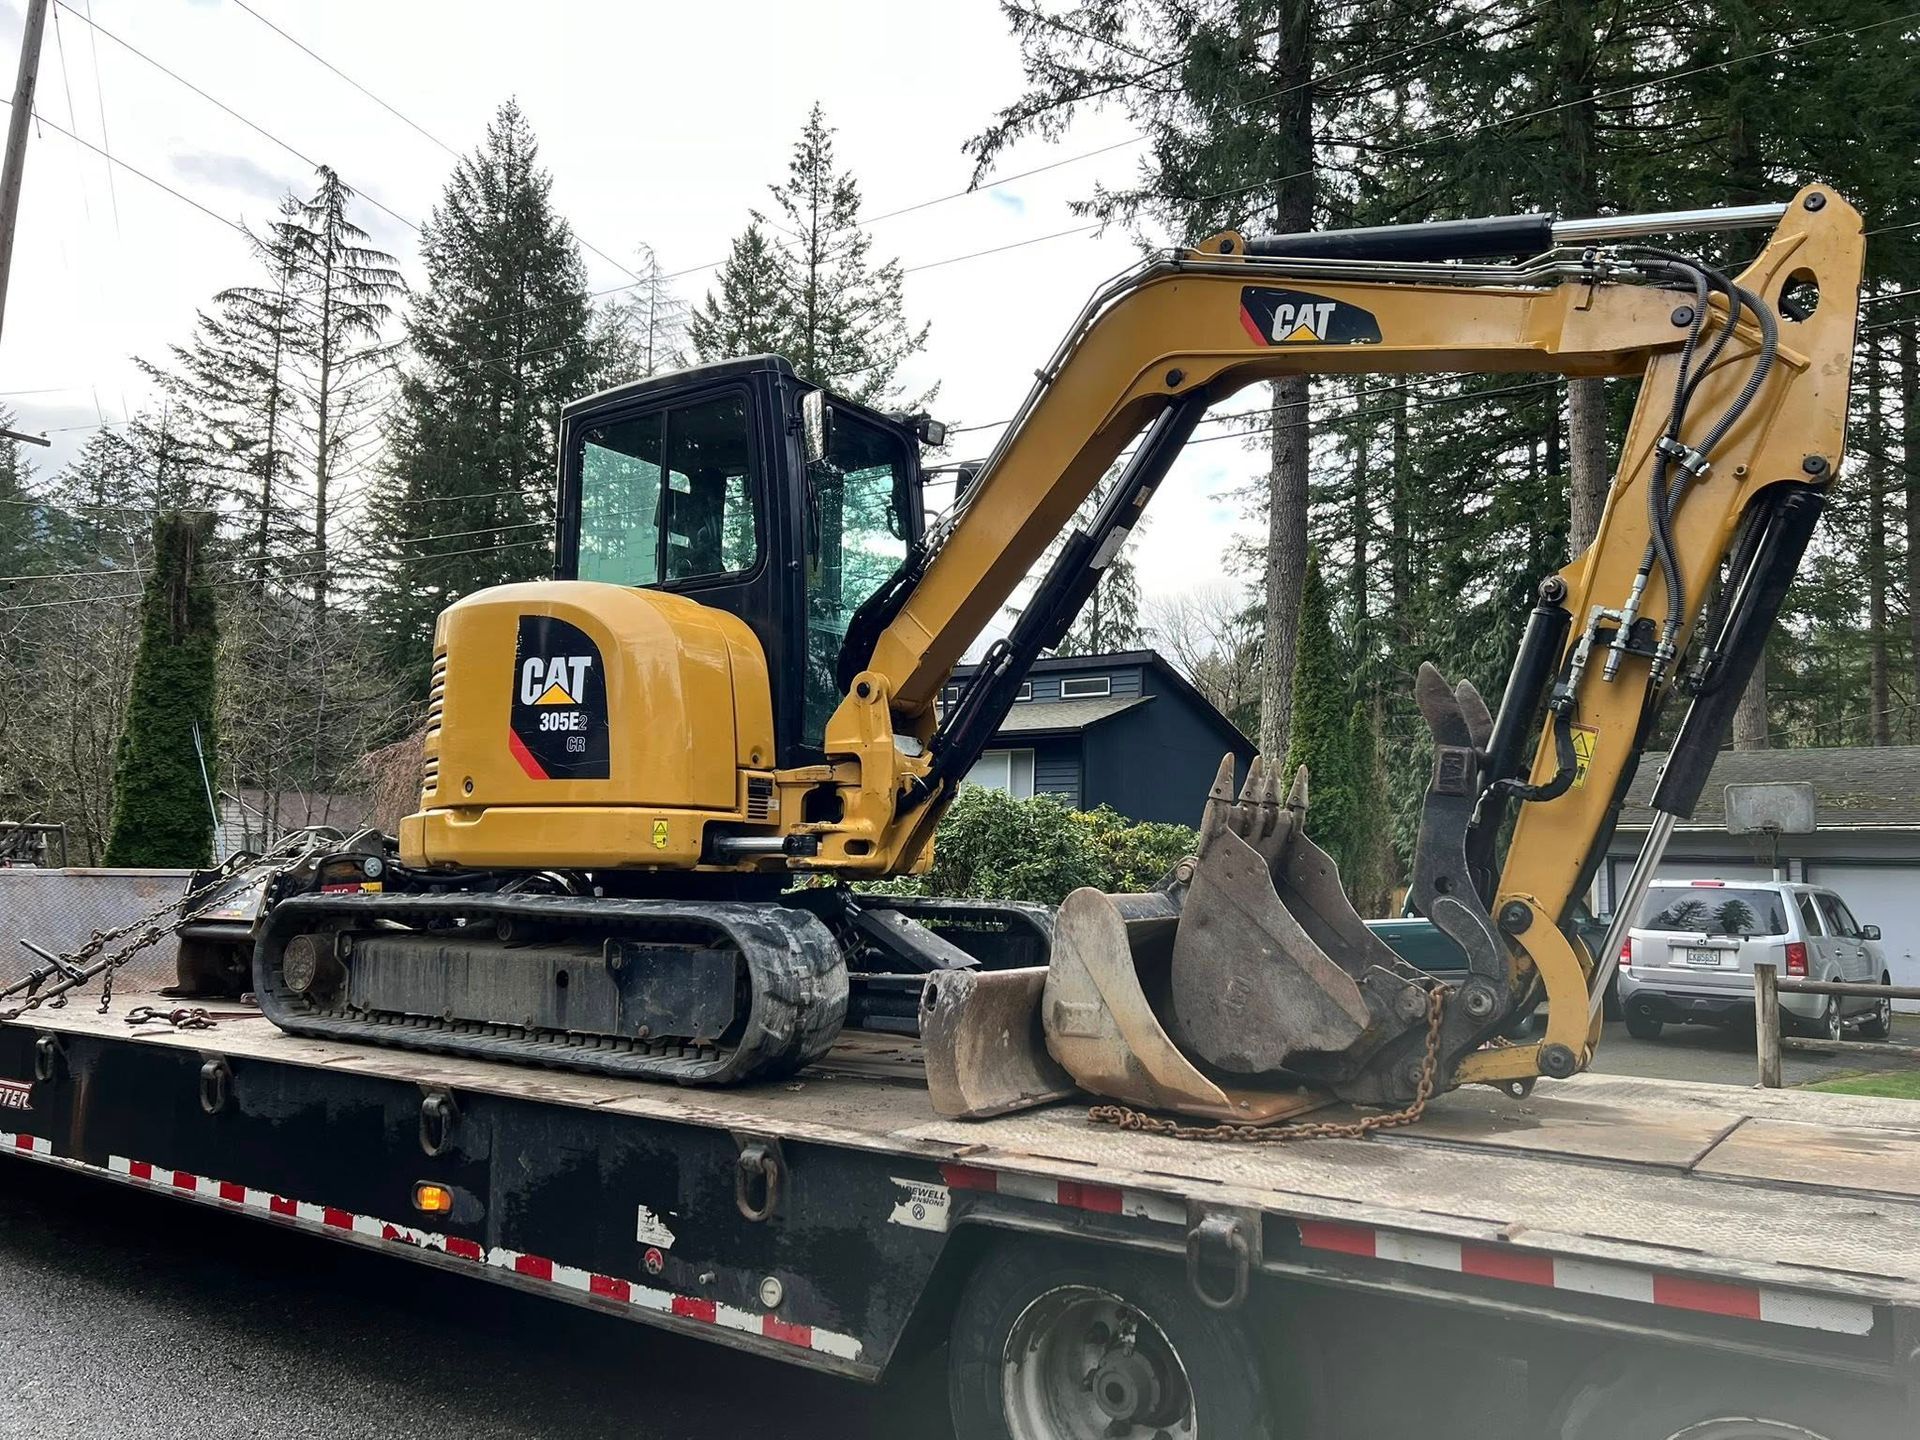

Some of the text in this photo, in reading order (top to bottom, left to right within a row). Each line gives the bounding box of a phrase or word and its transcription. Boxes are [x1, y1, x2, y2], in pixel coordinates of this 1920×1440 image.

[1272, 302, 1337, 341] CAT
[521, 656, 592, 705] CAT
[539, 711, 588, 731] 305E2
[566, 736, 586, 752] CR
